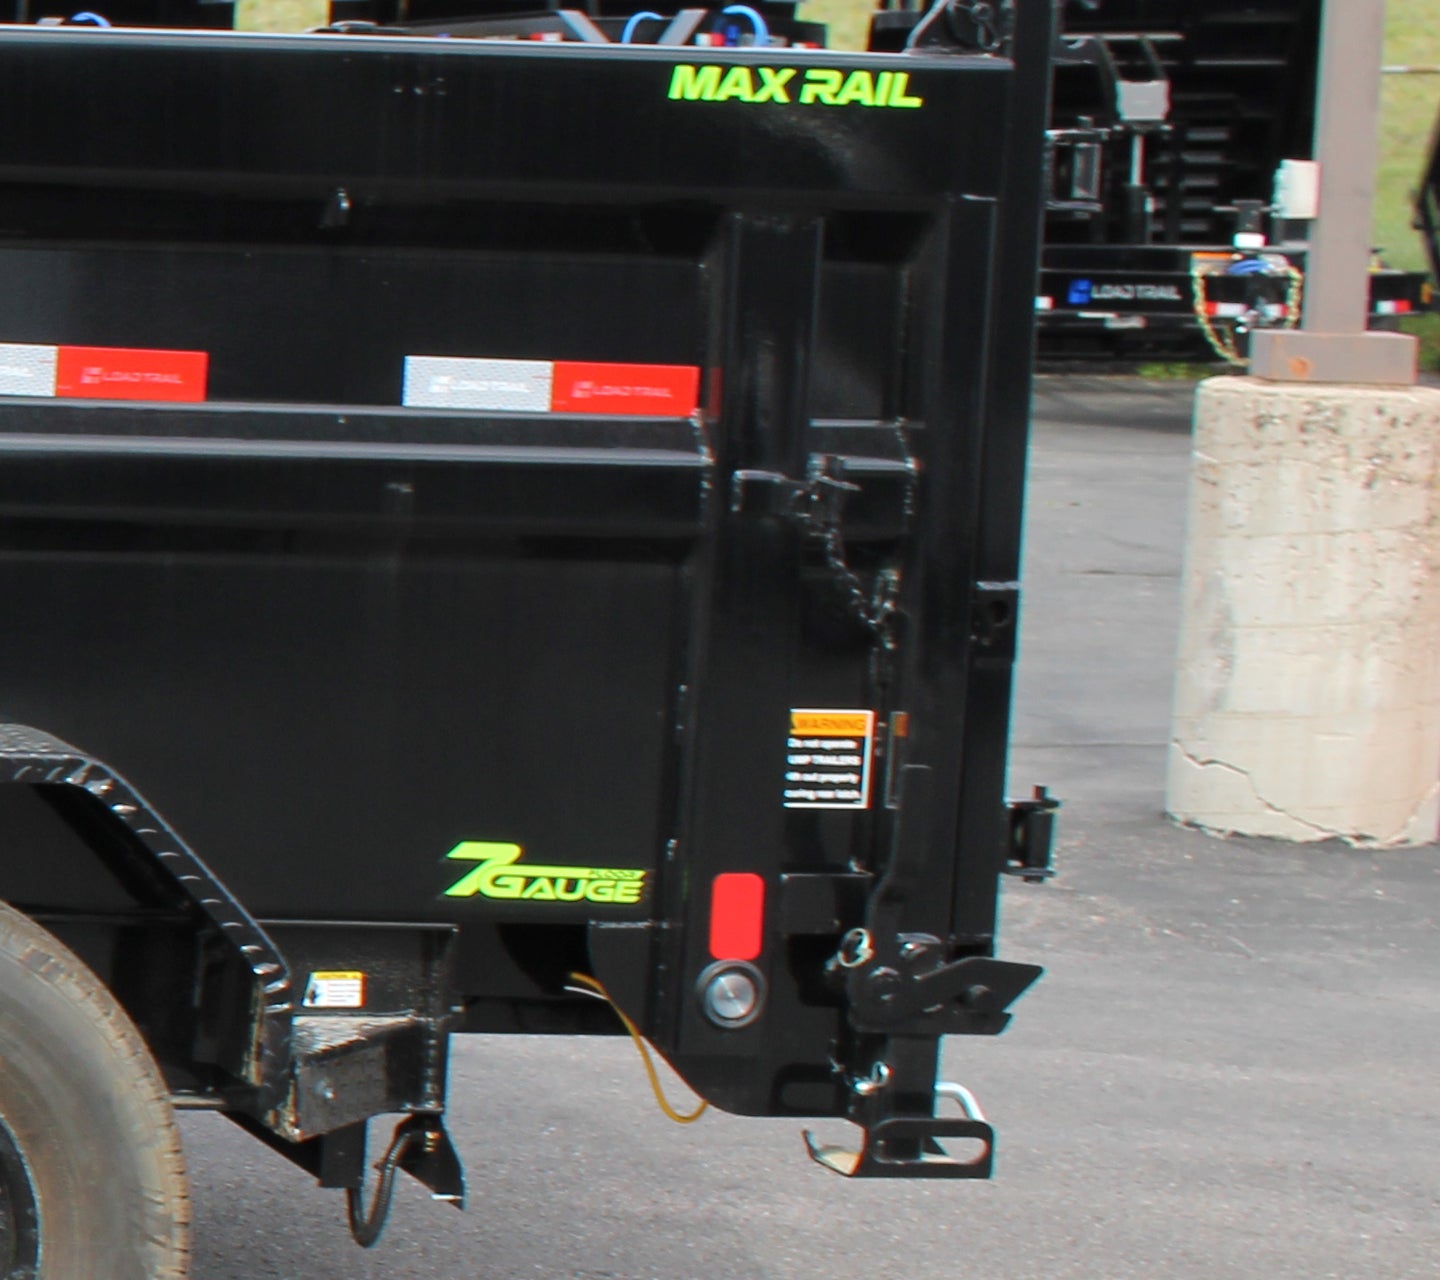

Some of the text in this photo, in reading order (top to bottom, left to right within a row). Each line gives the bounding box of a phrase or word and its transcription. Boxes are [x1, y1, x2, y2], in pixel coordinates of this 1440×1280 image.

[667, 64, 923, 108] MAX RAIL
[444, 840, 644, 904] 7 GAUGE
